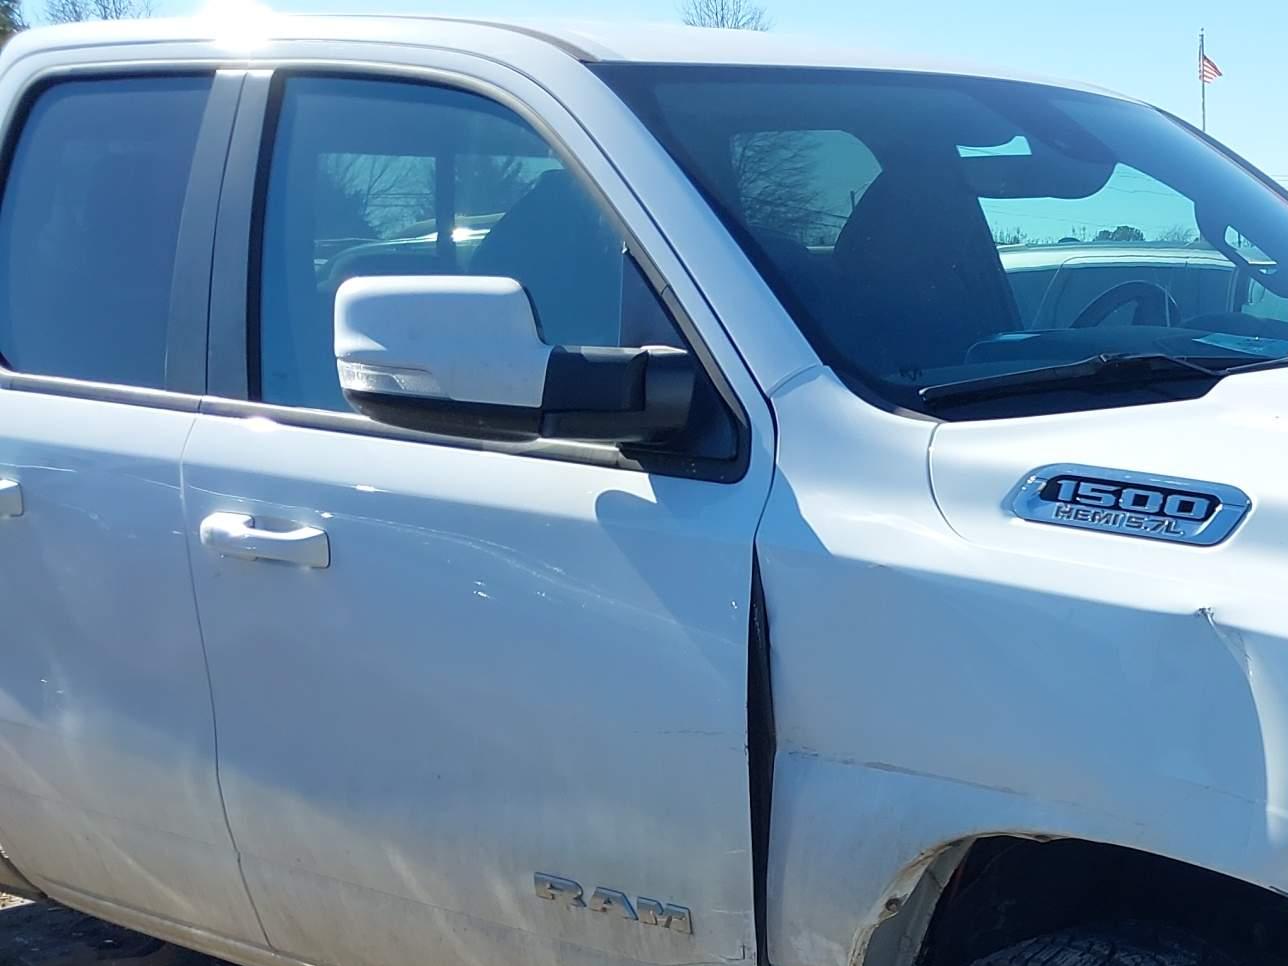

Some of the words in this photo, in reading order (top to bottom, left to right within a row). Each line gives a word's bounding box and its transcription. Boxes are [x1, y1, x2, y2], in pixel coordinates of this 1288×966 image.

[1054, 502, 1119, 526] HEMI
[1124, 511, 1184, 535] 5.7L
[1056, 479, 1211, 520] 1500
[534, 872, 694, 936] RAM
